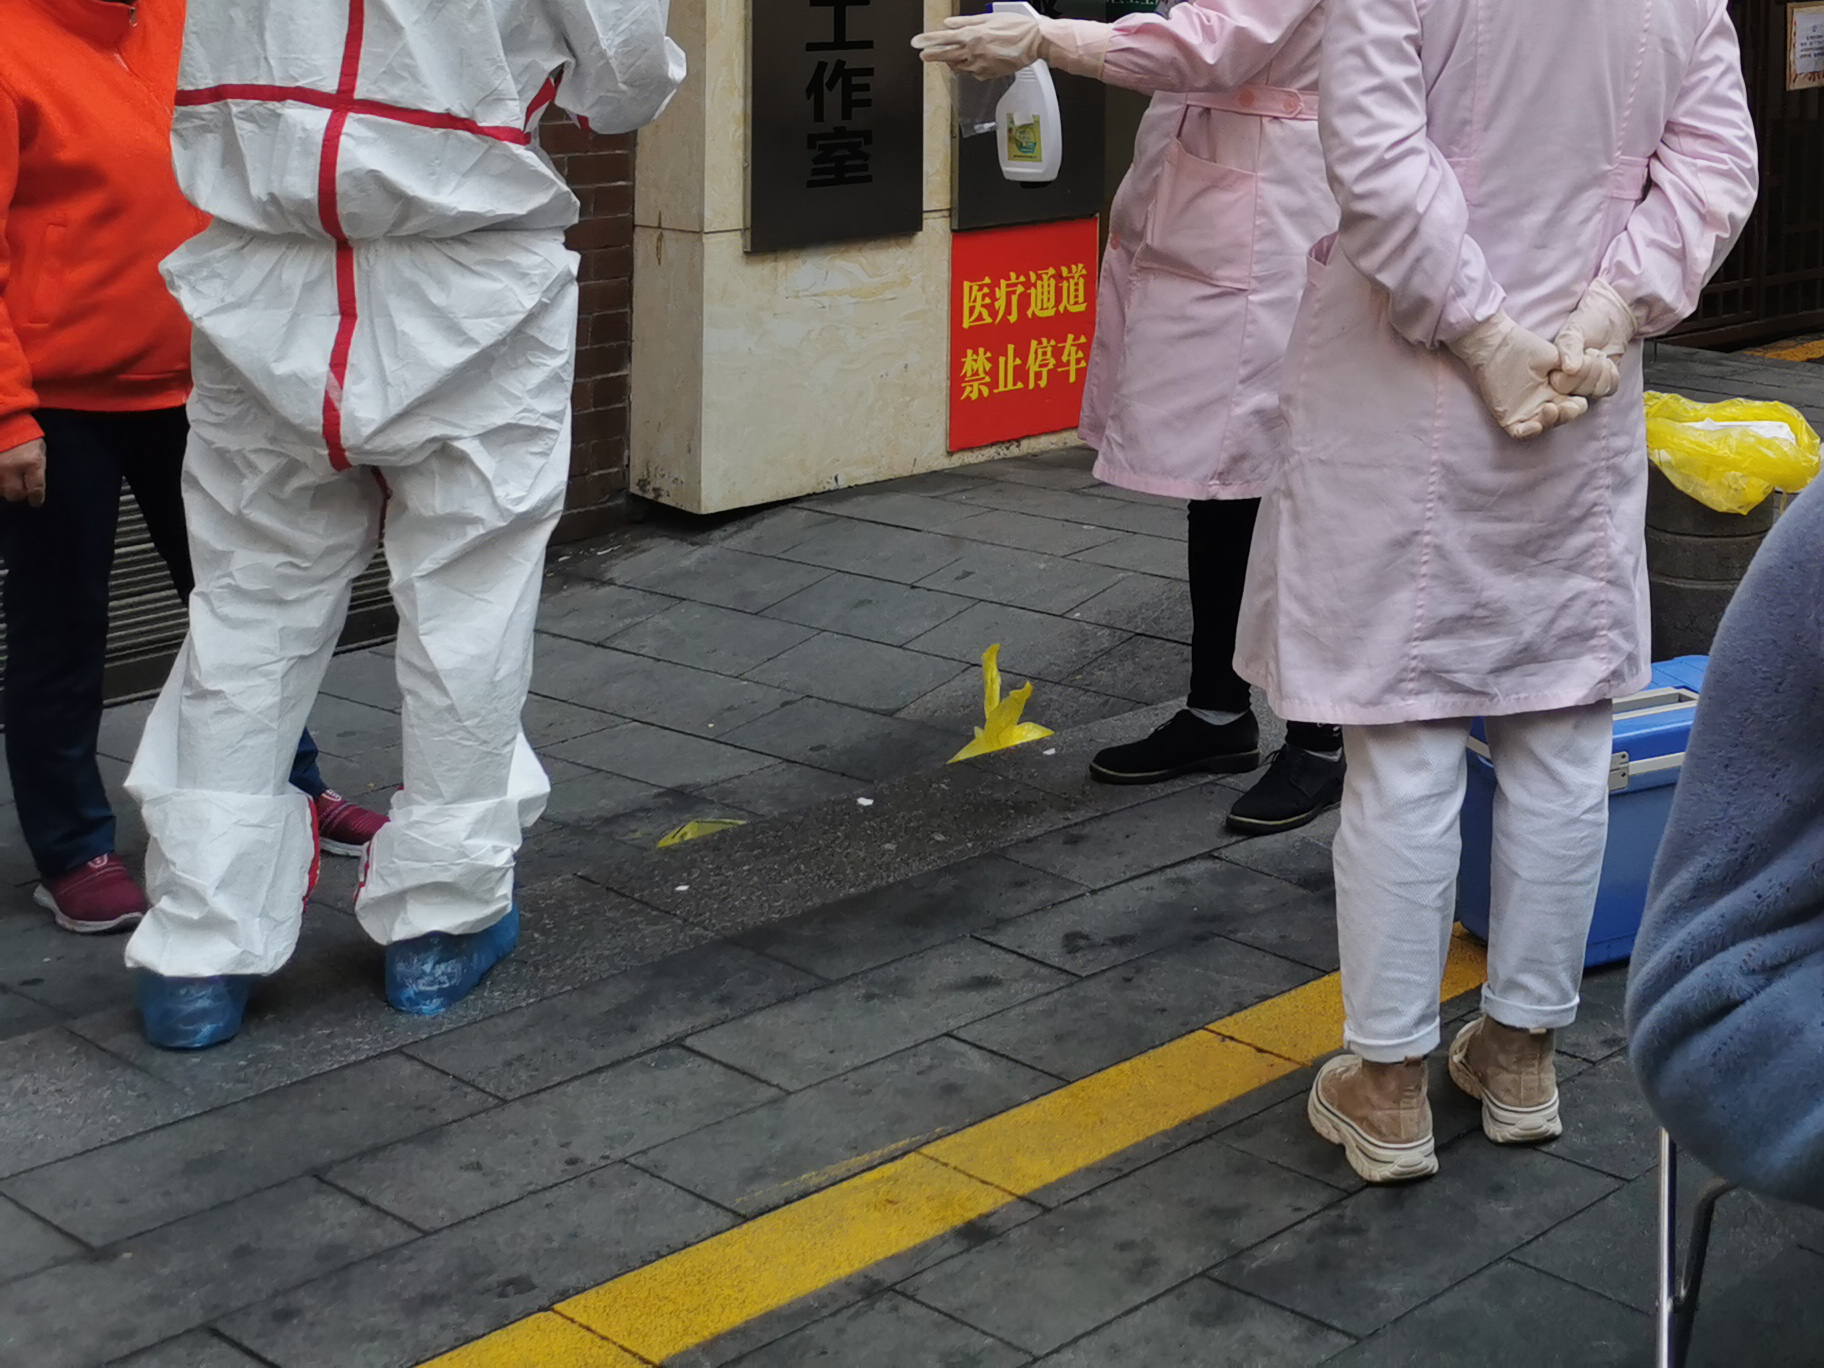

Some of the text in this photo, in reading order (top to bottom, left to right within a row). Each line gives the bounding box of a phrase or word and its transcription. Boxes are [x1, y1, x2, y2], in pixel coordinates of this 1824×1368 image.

[961, 263, 1088, 329] 医疗通道
[960, 333, 1088, 401] 禁止停车
